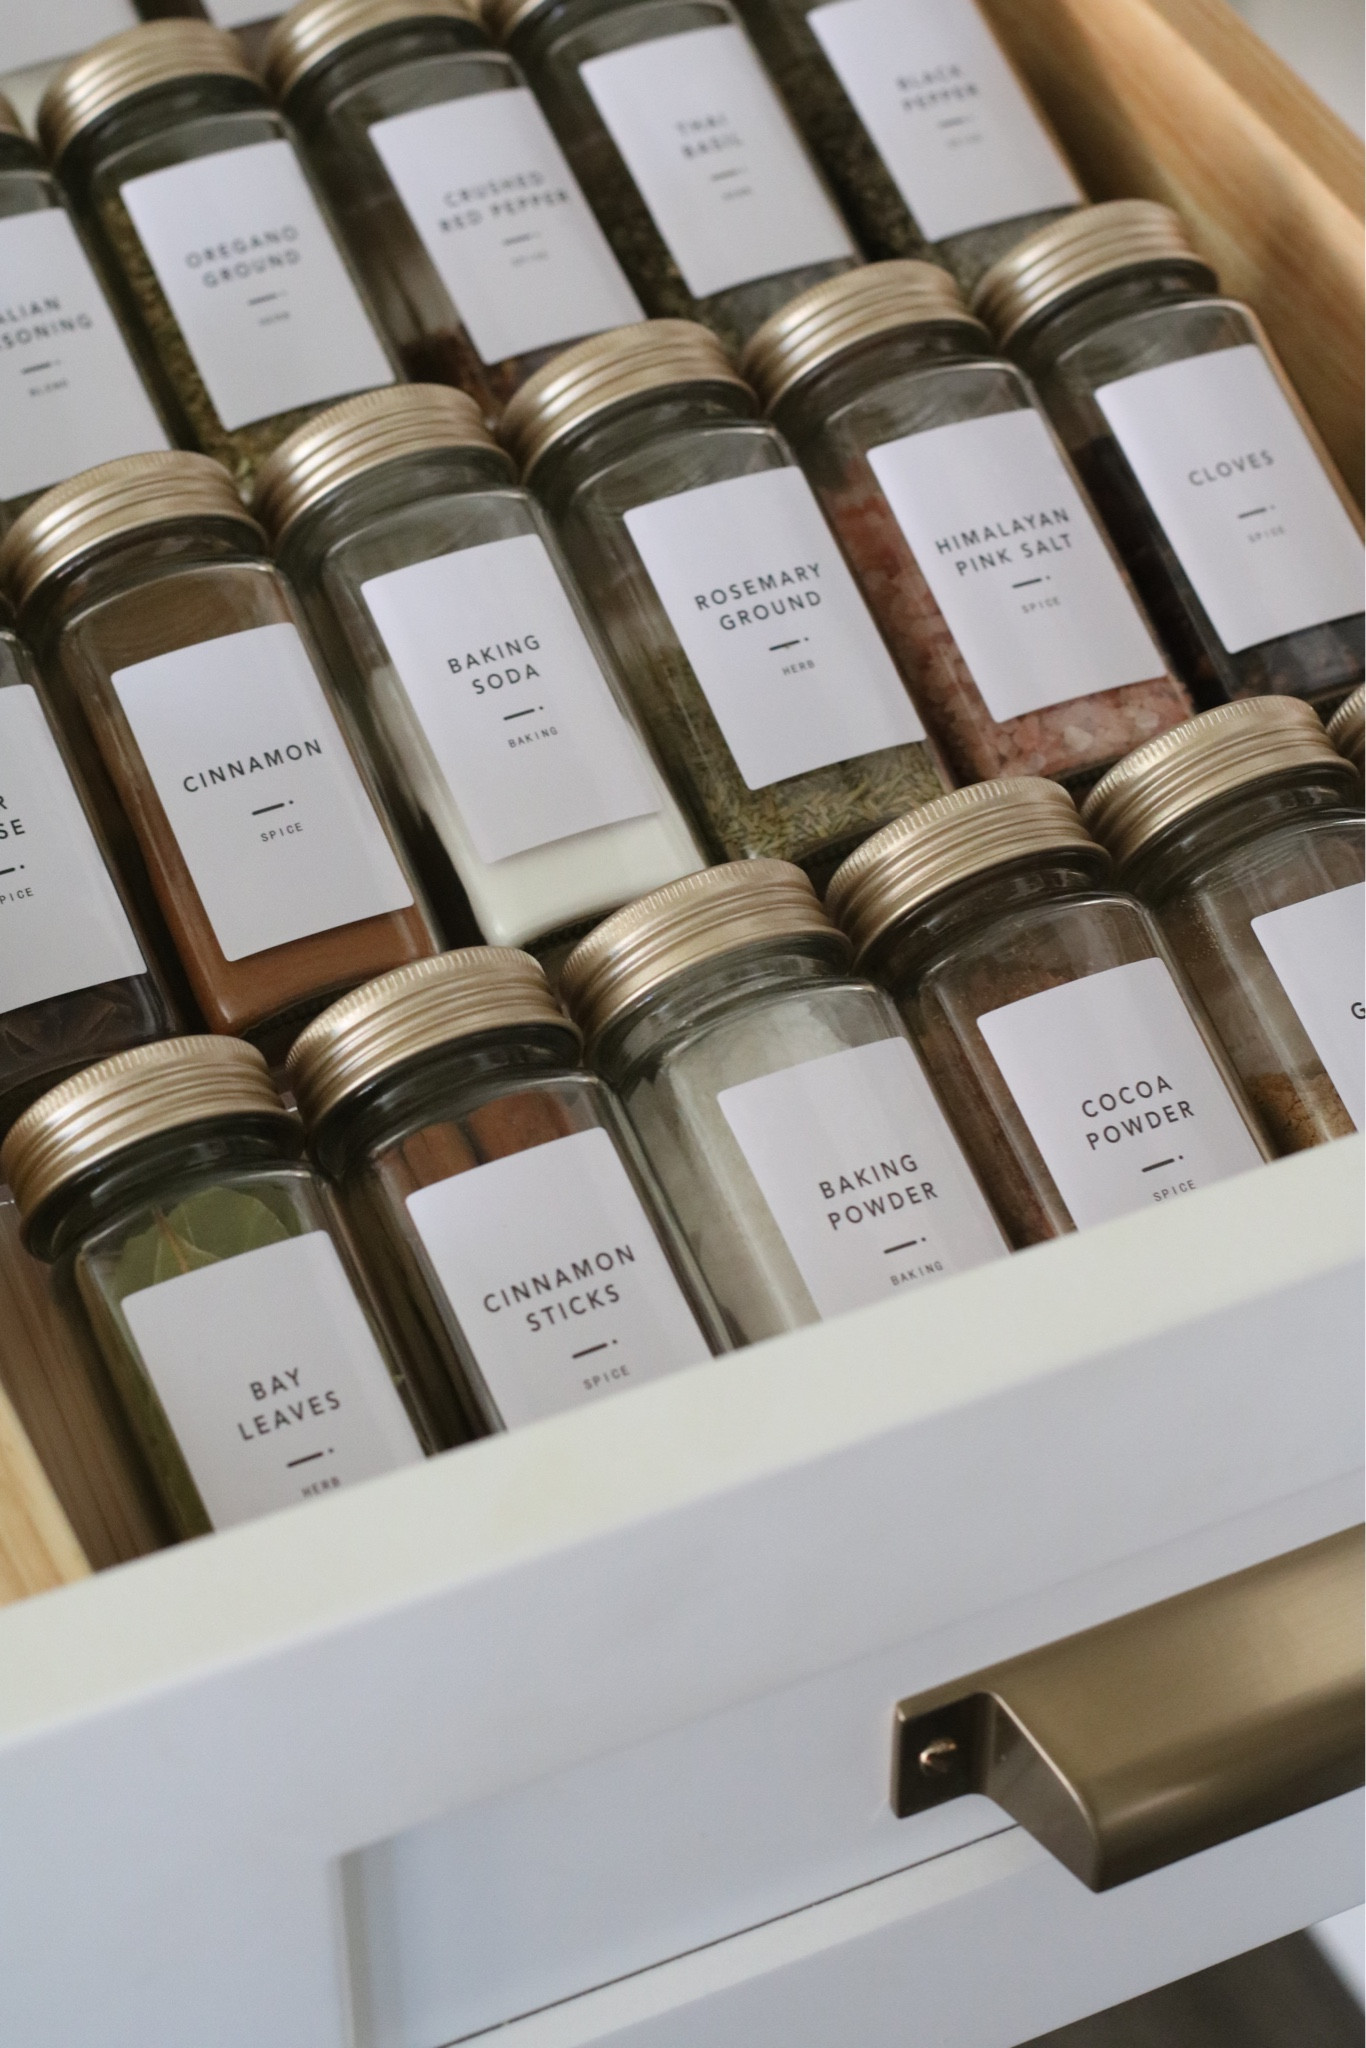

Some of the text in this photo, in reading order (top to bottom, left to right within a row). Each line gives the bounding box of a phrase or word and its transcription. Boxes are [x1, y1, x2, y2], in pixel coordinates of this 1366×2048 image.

[444, 171, 543, 207] CRUSHED
[439, 189, 569, 232] RED PEPPER
[186, 226, 298, 268] OREGANO
[203, 249, 300, 288] GROUND
[0, 314, 92, 349] SONING
[1188, 450, 1274, 486] CLOVES
[935, 509, 1069, 554] HIMALAYAN
[1247, 525, 1285, 543] SPICE
[955, 533, 1071, 576] PINK SALT
[694, 563, 819, 610] ROSEMARY
[1021, 596, 1060, 614] SPICE
[720, 591, 821, 630] GROUND
[447, 635, 540, 674] BAKING
[782, 660, 815, 675] HERB
[472, 664, 539, 695] SODA
[508, 727, 558, 748] BAKING
[183, 740, 322, 792] CINNAMON
[260, 822, 303, 842] SPICE
[1082, 1076, 1172, 1118] COCOA
[1086, 1101, 1194, 1150] POWDER
[819, 1154, 918, 1199] BAKING
[1153, 1180, 1196, 1202] SPICE
[828, 1182, 937, 1230] POWDER
[484, 1245, 635, 1313] CINNAMON
[890, 1261, 943, 1286] BAKING
[526, 1284, 619, 1332] STICKS
[250, 1368, 299, 1401] BAY
[583, 1365, 630, 1390] SPICE
[238, 1391, 340, 1441] LEAVES
[301, 1476, 340, 1497] HERB
